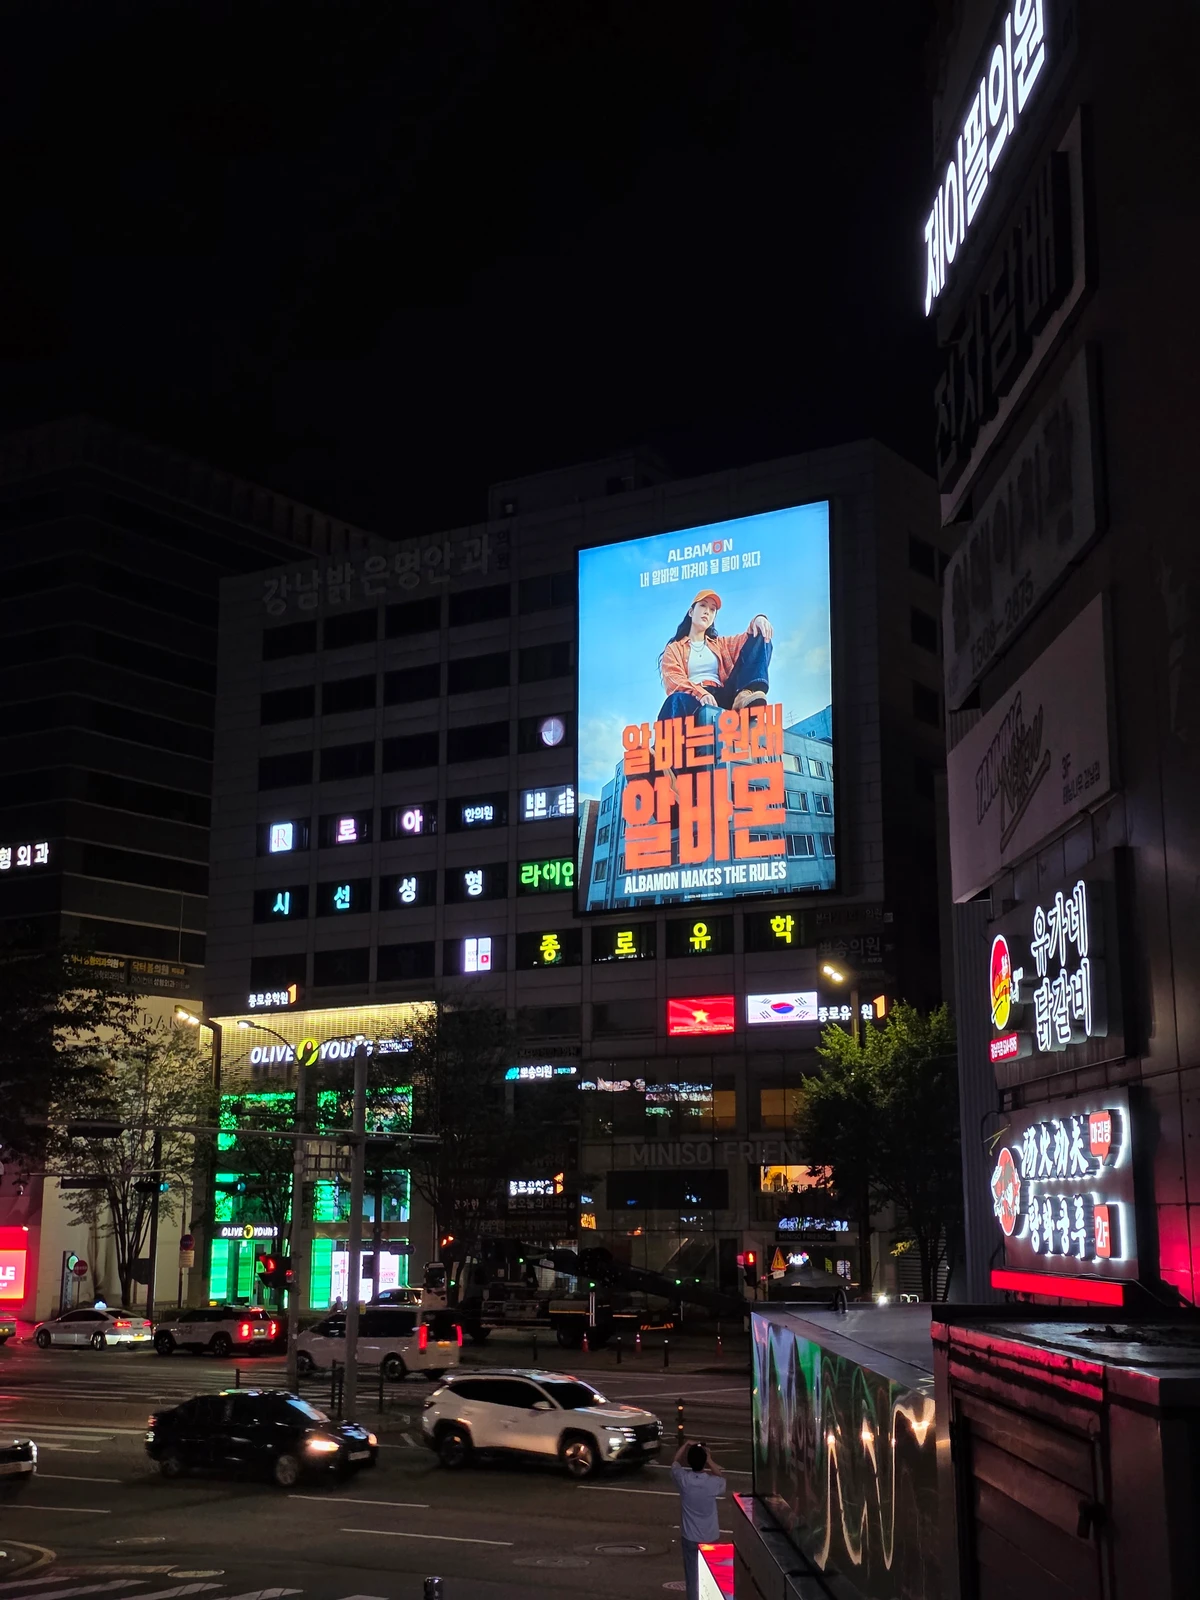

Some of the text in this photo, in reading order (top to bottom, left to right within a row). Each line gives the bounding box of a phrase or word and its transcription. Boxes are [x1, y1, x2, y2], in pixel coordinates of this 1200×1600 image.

[924, 0, 1046, 318] 제이필의원
[934, 160, 1057, 494] 전자담배
[667, 538, 733, 563] ALBAMON
[261, 533, 493, 617] 강남밝은명안과
[640, 572, 650, 588] 내
[652, 567, 679, 586] 알바엔
[681, 562, 709, 580] 지켜야
[742, 551, 762, 568] 있다
[622, 703, 784, 776] 알바는 원래
[464, 805, 494, 824] 한의원
[622, 761, 786, 871] 알바몬
[624, 874, 679, 894] ALBAMON
[681, 868, 722, 889] MAKES
[723, 864, 747, 884] THE
[749, 861, 787, 882] RULES
[1031, 880, 1089, 977] 유가네
[818, 1003, 873, 1022] 종로유원
[1034, 957, 1092, 1052] 닭갈비
[250, 1044, 295, 1064] OLIVE
[1090, 1122, 1112, 1144] 마라탕
[629, 1141, 712, 1167] MINISO
[221, 1226, 243, 1237] OLIVE
[1096, 1216, 1109, 1249] 2F
